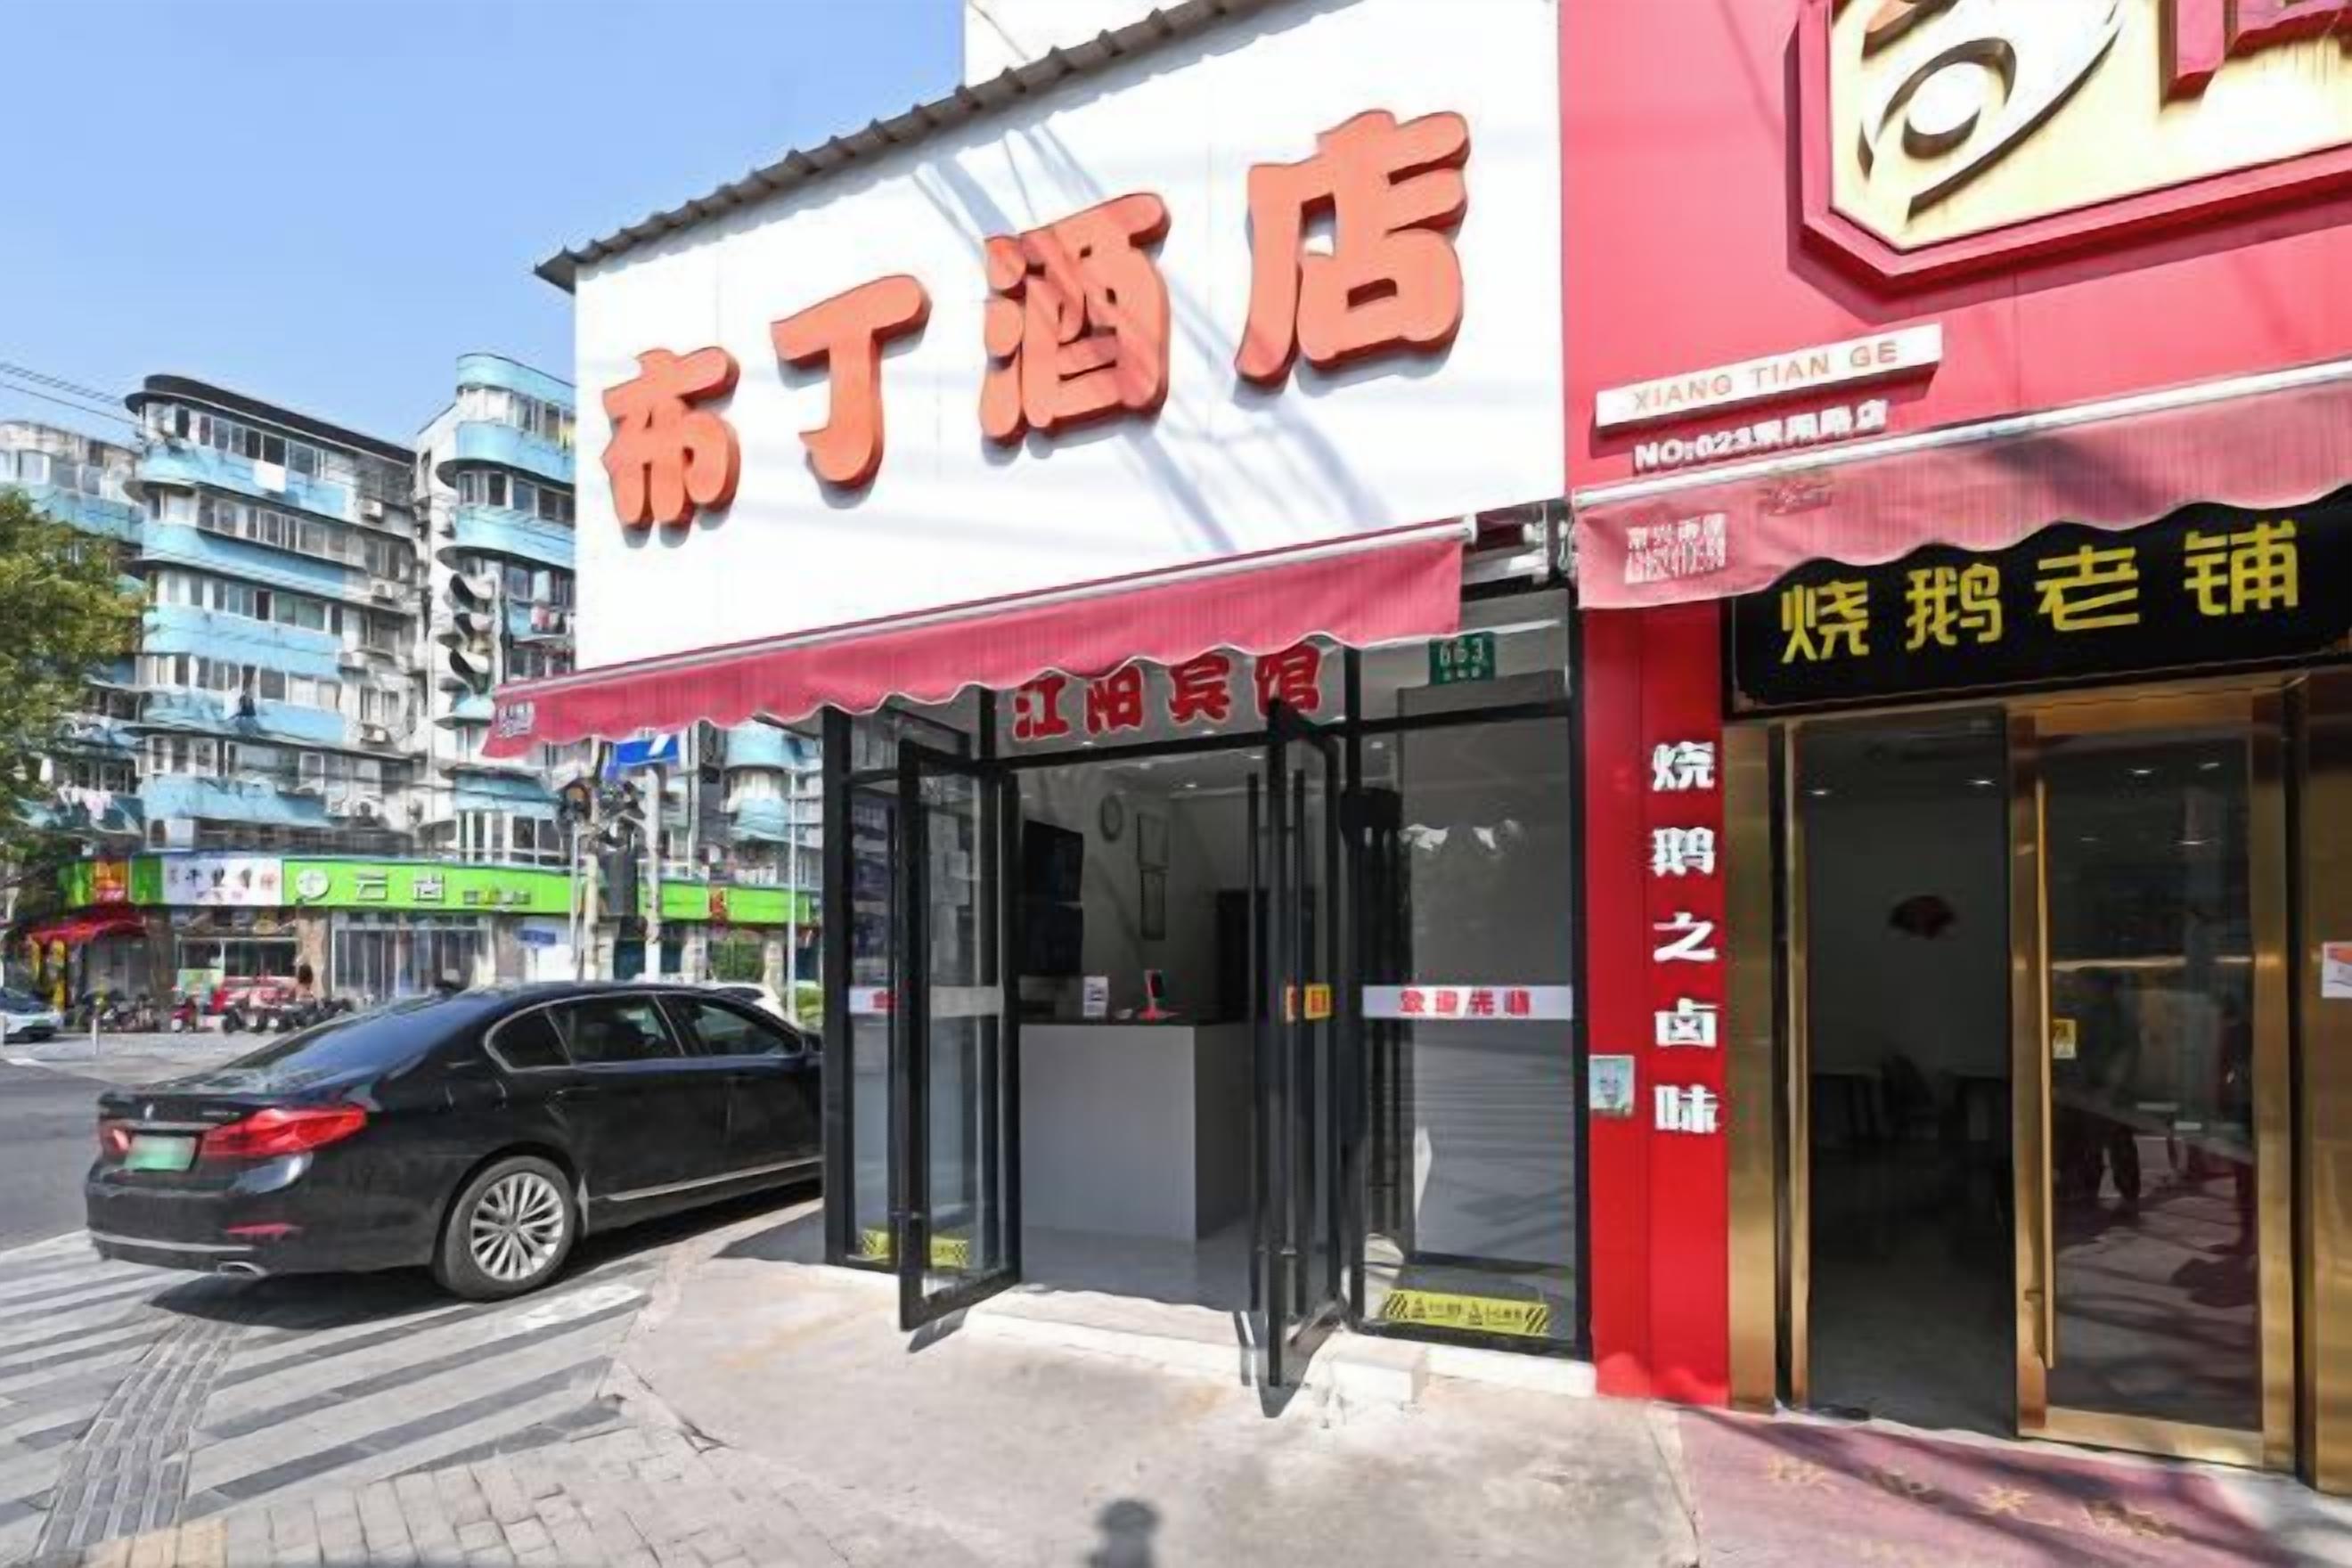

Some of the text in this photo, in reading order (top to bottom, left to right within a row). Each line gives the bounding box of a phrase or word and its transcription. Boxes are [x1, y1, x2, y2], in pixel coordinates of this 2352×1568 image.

[602, 107, 1471, 530] 布丁酒店
[1633, 339, 1899, 412] XIANG TIAN GE
[1781, 519, 2299, 664] 烧鹅老铺
